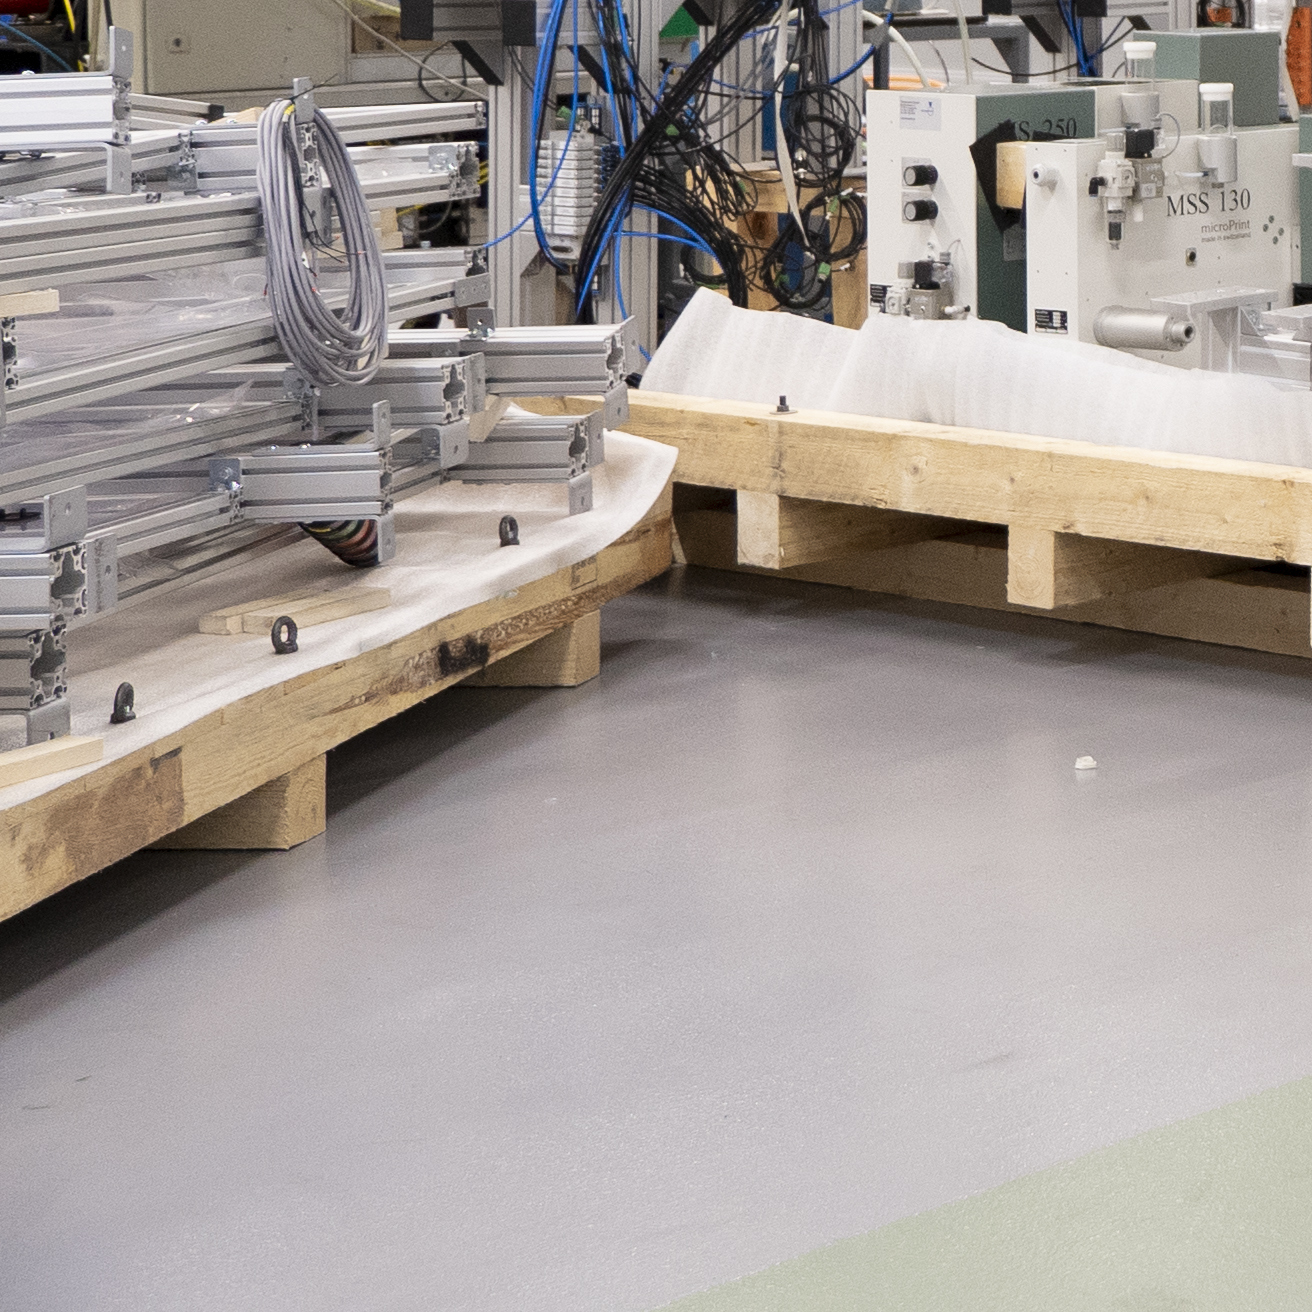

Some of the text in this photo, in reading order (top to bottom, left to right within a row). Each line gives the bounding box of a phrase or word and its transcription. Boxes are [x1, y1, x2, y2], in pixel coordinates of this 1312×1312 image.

[1041, 117, 1077, 138] 250
[1166, 188, 1251, 217] MSS 130
[1201, 219, 1250, 234] microPrint
